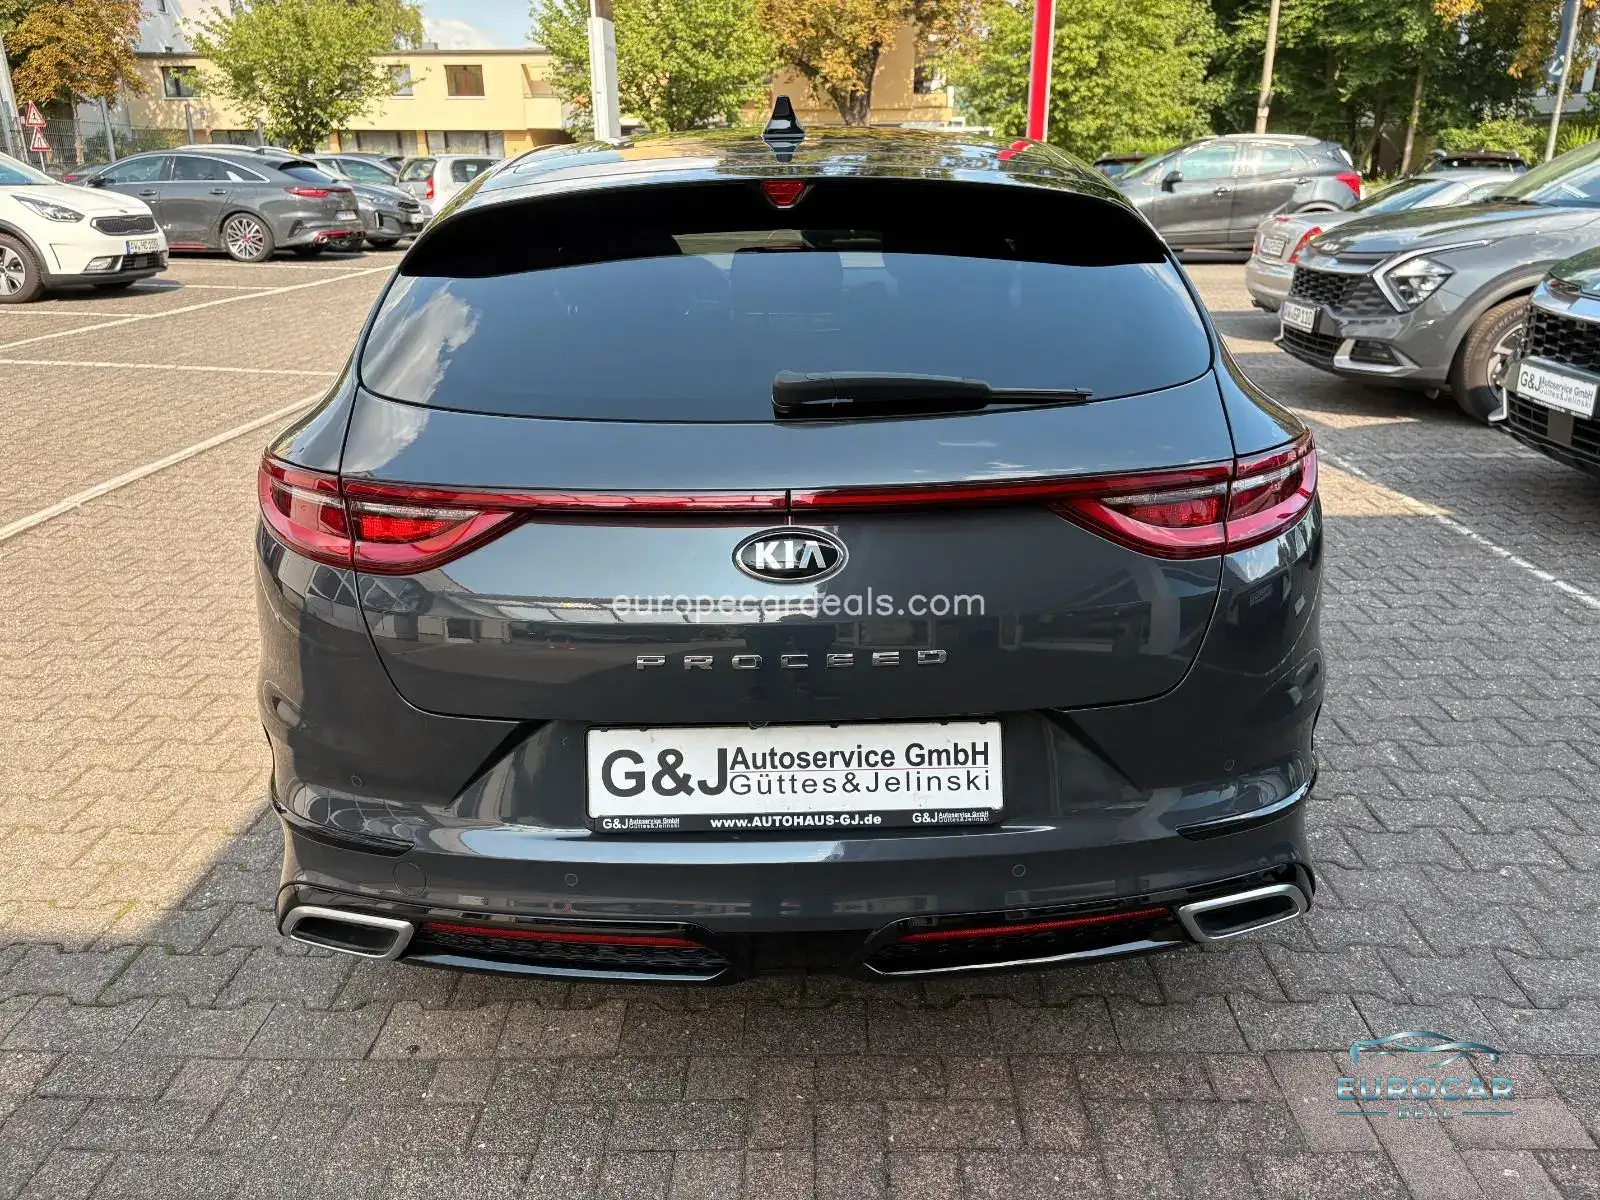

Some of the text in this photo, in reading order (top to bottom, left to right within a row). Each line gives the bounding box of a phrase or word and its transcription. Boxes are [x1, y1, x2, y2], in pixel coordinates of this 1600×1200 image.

[1520, 371, 1542, 392] G&J
[755, 541, 826, 570] KIA
[636, 649, 948, 670] PROCEED
[729, 741, 989, 770] Autoservice GmbH
[601, 748, 728, 797] G&J
[729, 770, 990, 796] Güttes&Jelinski
[602, 818, 629, 829] G&J
[710, 813, 882, 828] www.AUTOHAUS-GJ.de
[912, 812, 938, 824] G&J
